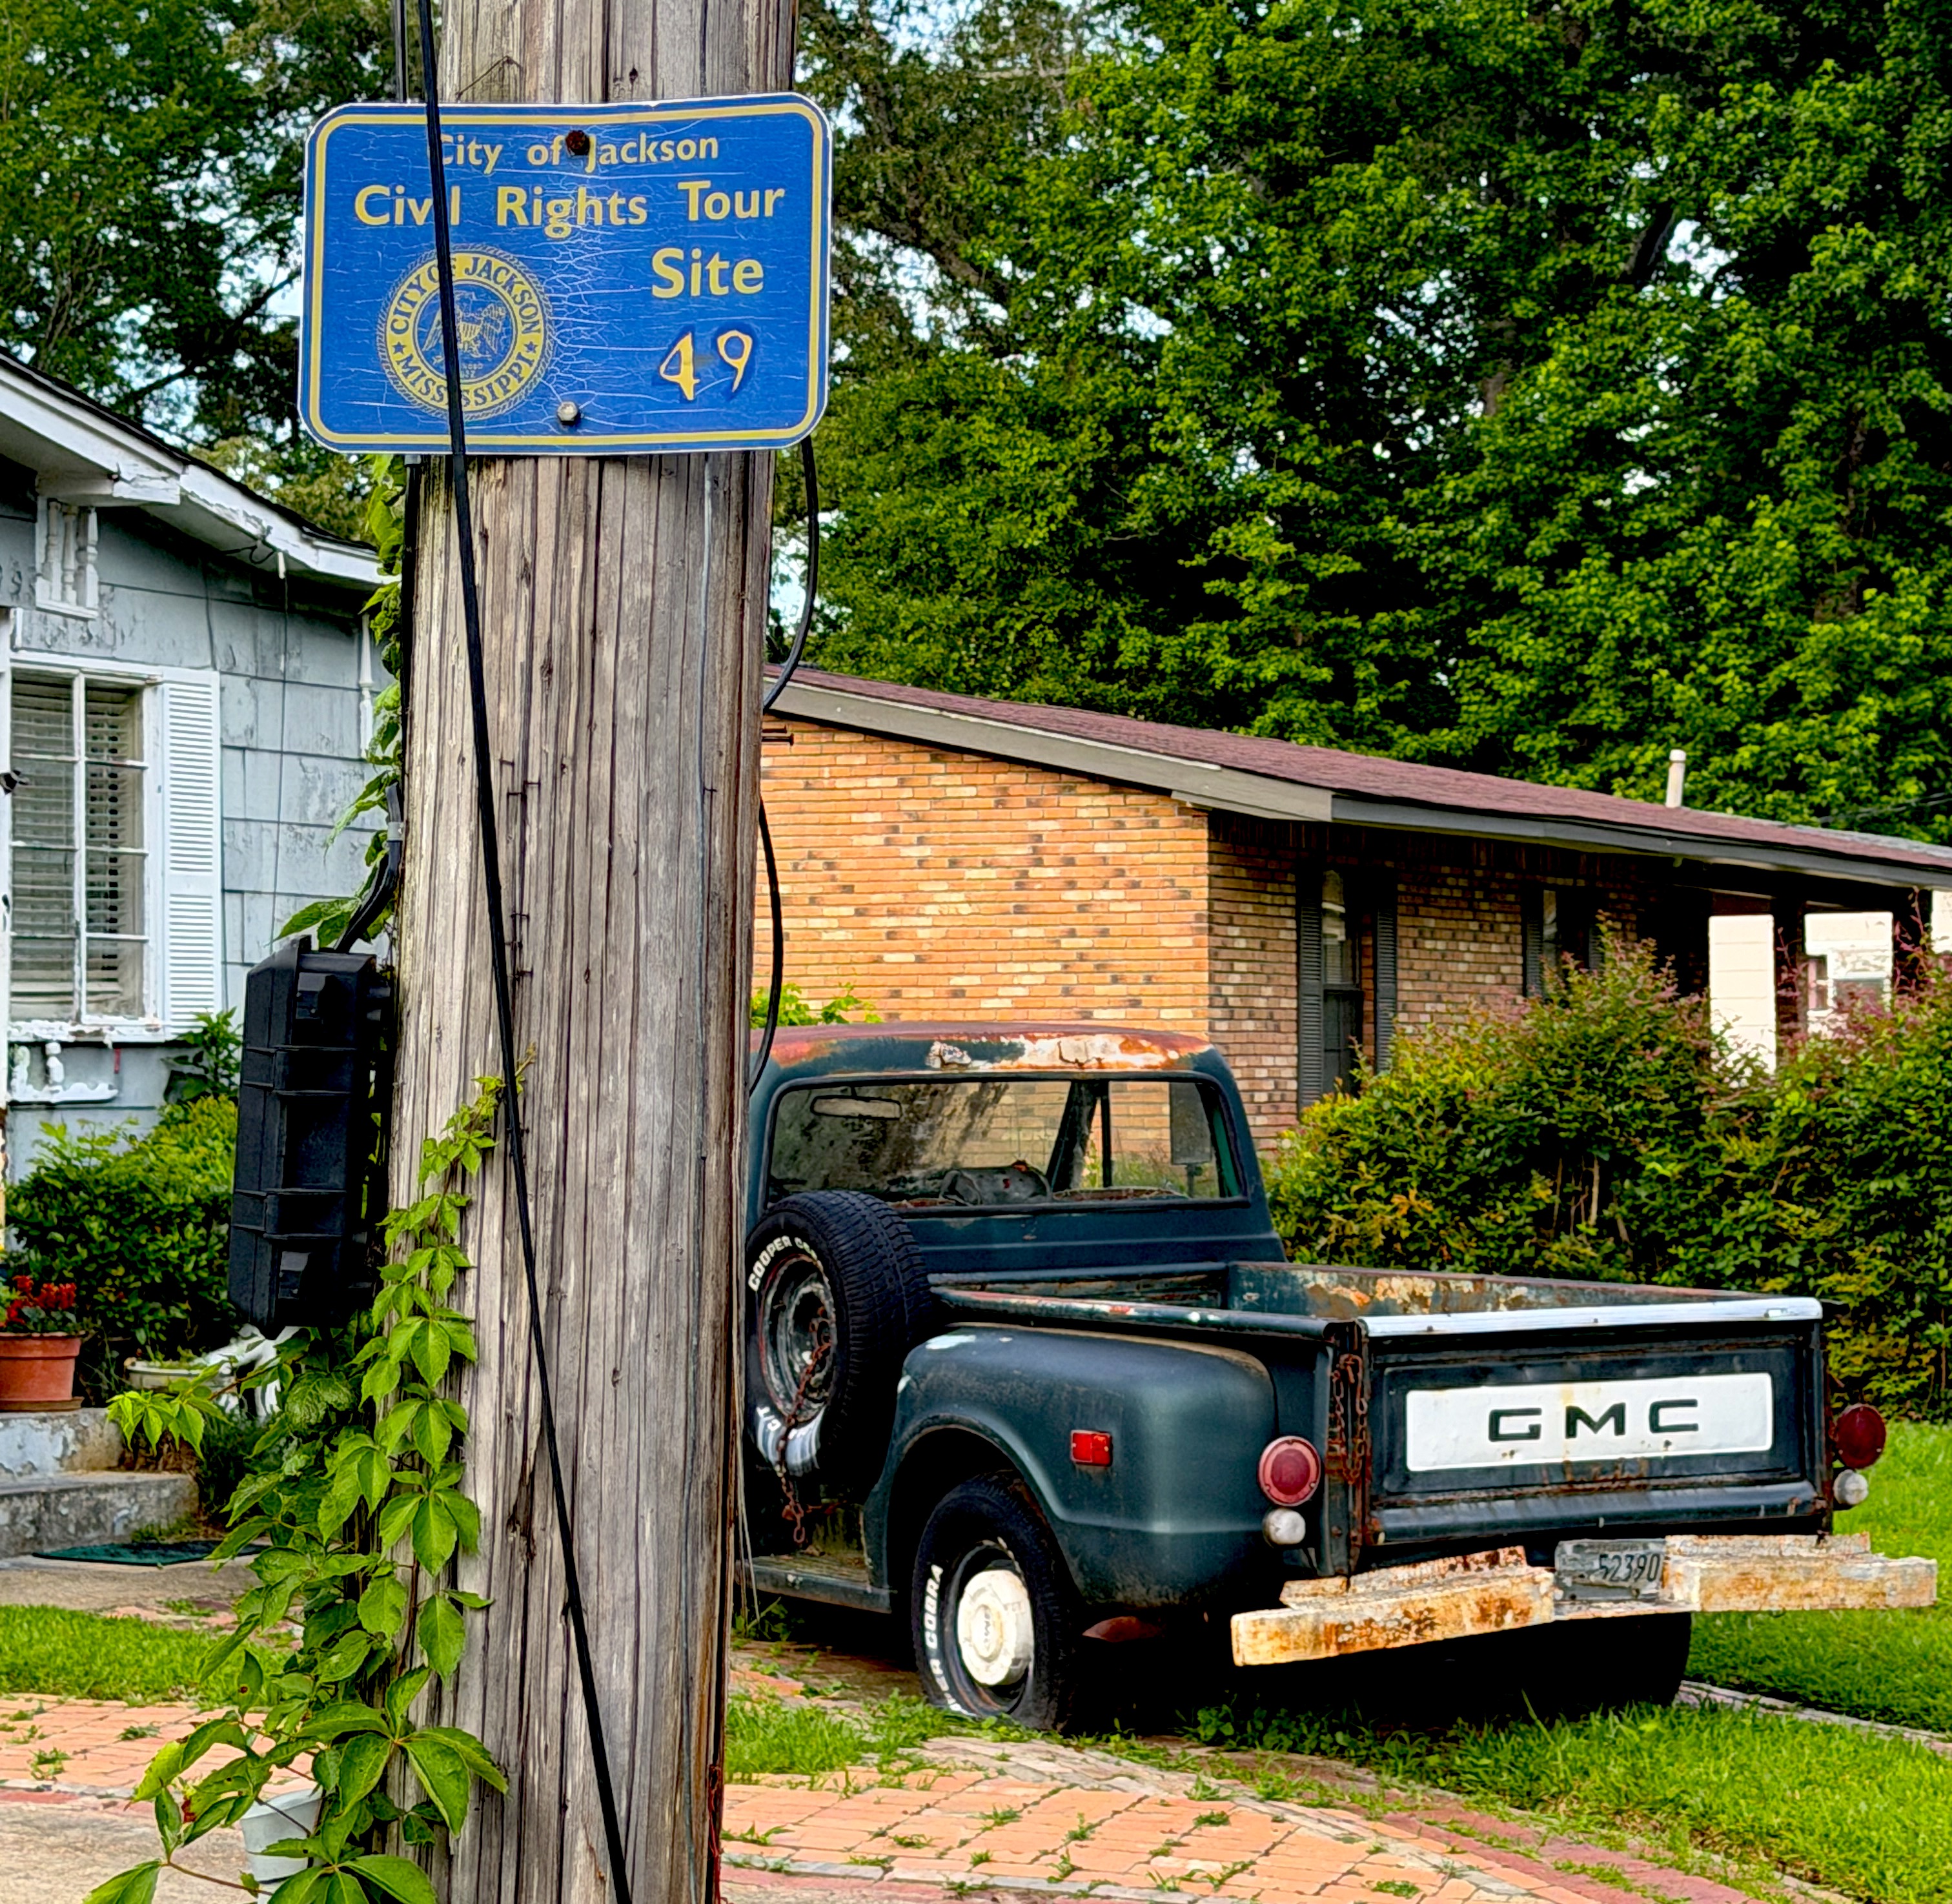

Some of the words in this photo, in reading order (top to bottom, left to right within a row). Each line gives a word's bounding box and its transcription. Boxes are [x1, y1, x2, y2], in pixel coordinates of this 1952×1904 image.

[527, 134, 566, 166] of
[585, 132, 718, 174] Jackson
[354, 185, 461, 226] Civl
[496, 185, 648, 239] Rights
[677, 180, 786, 221] Tour
[390, 274, 429, 335] CITY
[463, 256, 542, 335] JACKSON
[651, 247, 764, 299] Site
[396, 351, 536, 408] MISSSSIPPI
[747, 1235, 793, 1291] COOPER
[1489, 1399, 1700, 1443] GMC
[1598, 1553, 1661, 1583] 52390
[924, 1564, 944, 1650] COBRA
